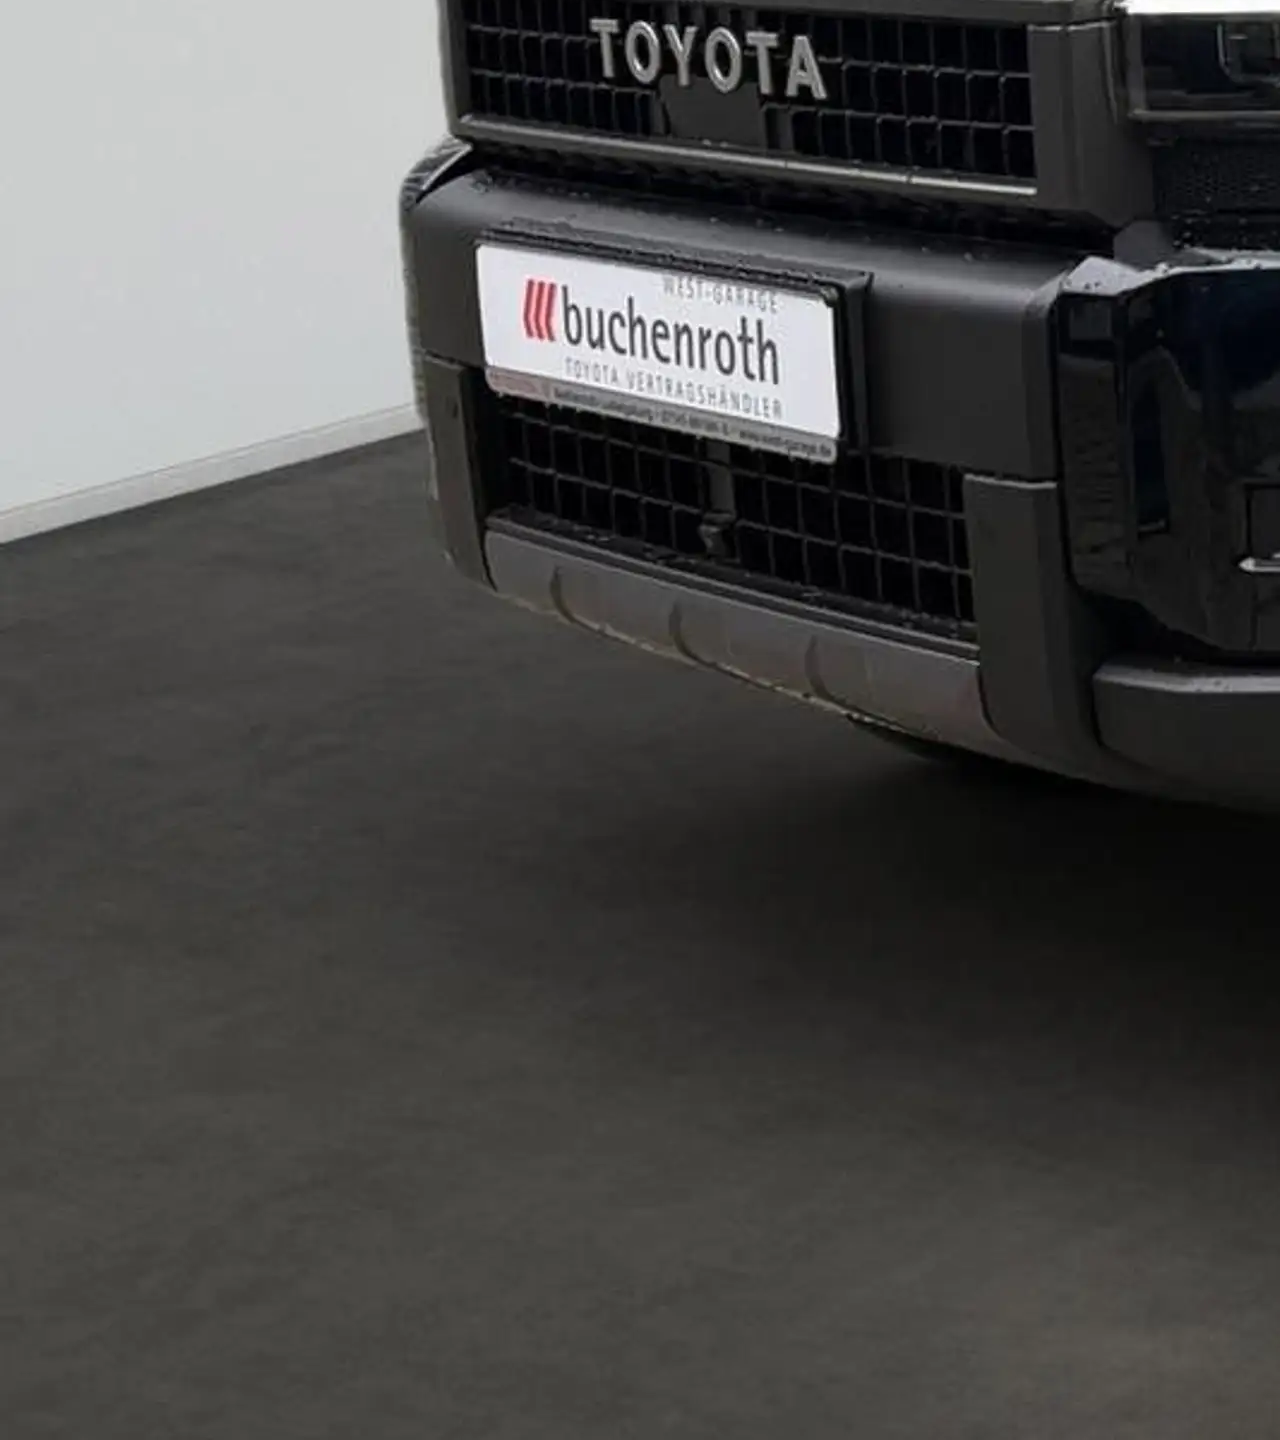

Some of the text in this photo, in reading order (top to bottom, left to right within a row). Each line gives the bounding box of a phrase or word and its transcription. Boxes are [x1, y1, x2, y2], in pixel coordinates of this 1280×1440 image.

[588, 18, 828, 100] TOYOTA
[663, 274, 780, 314] WEST-GARAGE
[560, 283, 780, 386] buchenroth
[565, 357, 620, 386] TOYOTA
